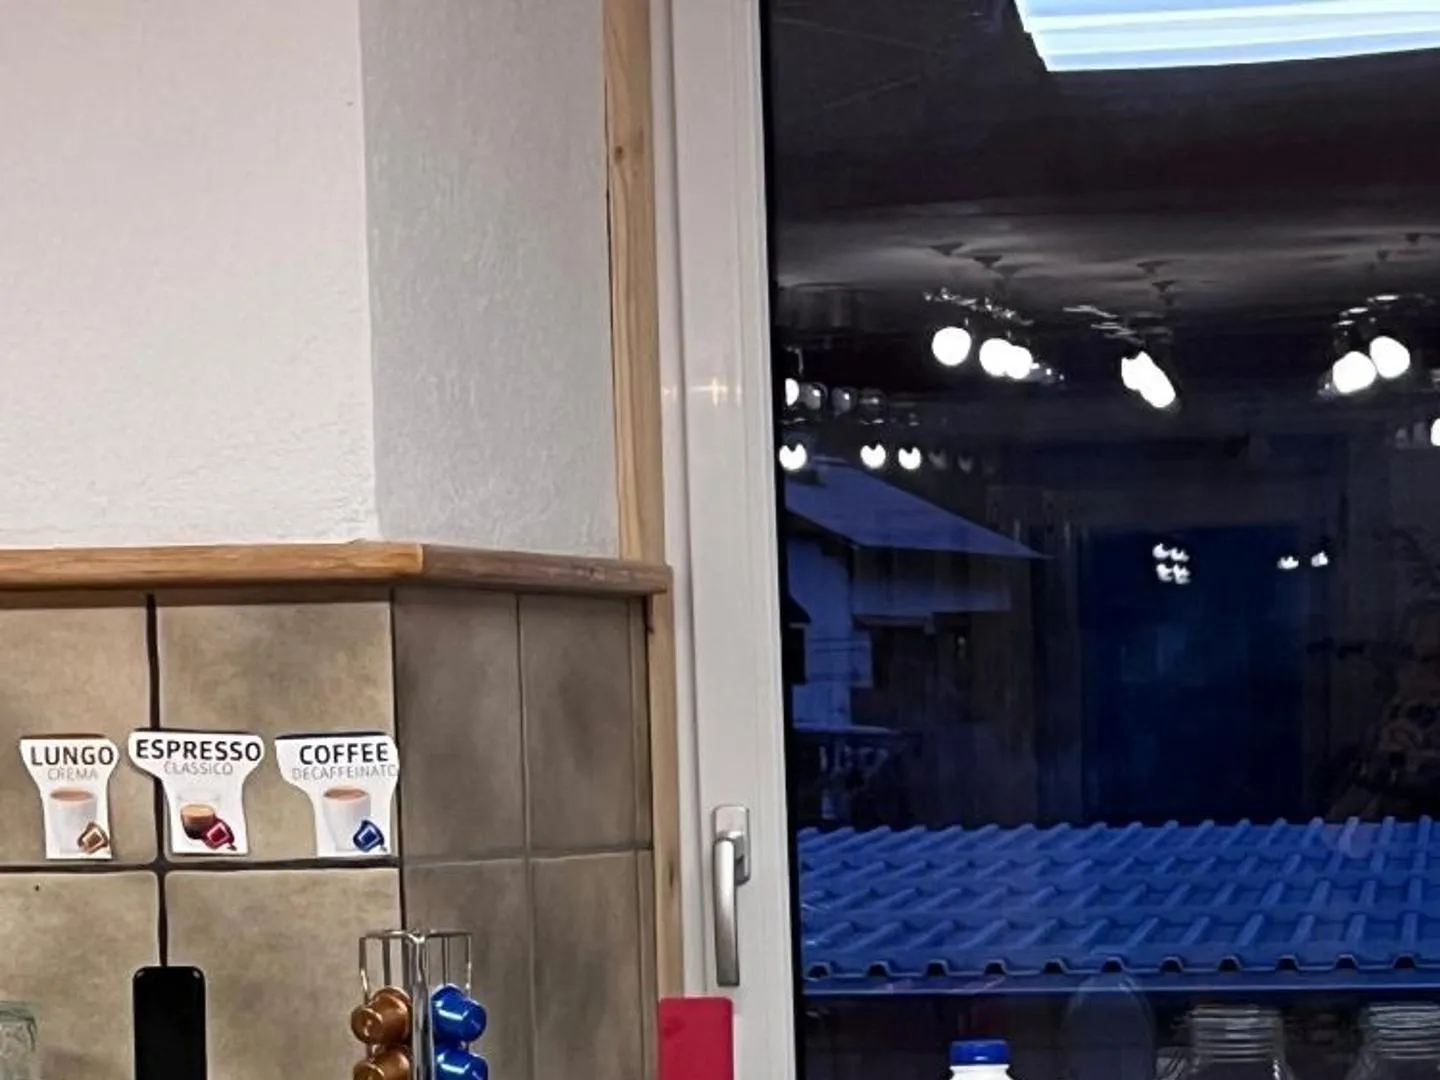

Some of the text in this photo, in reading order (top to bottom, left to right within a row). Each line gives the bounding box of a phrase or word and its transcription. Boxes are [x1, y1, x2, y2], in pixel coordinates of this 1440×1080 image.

[30, 746, 114, 766] LUNGO
[136, 739, 261, 761] ESPRESSO
[300, 742, 389, 765] COFFEE
[47, 767, 99, 780] CREMA
[163, 762, 233, 775] CLASSICO
